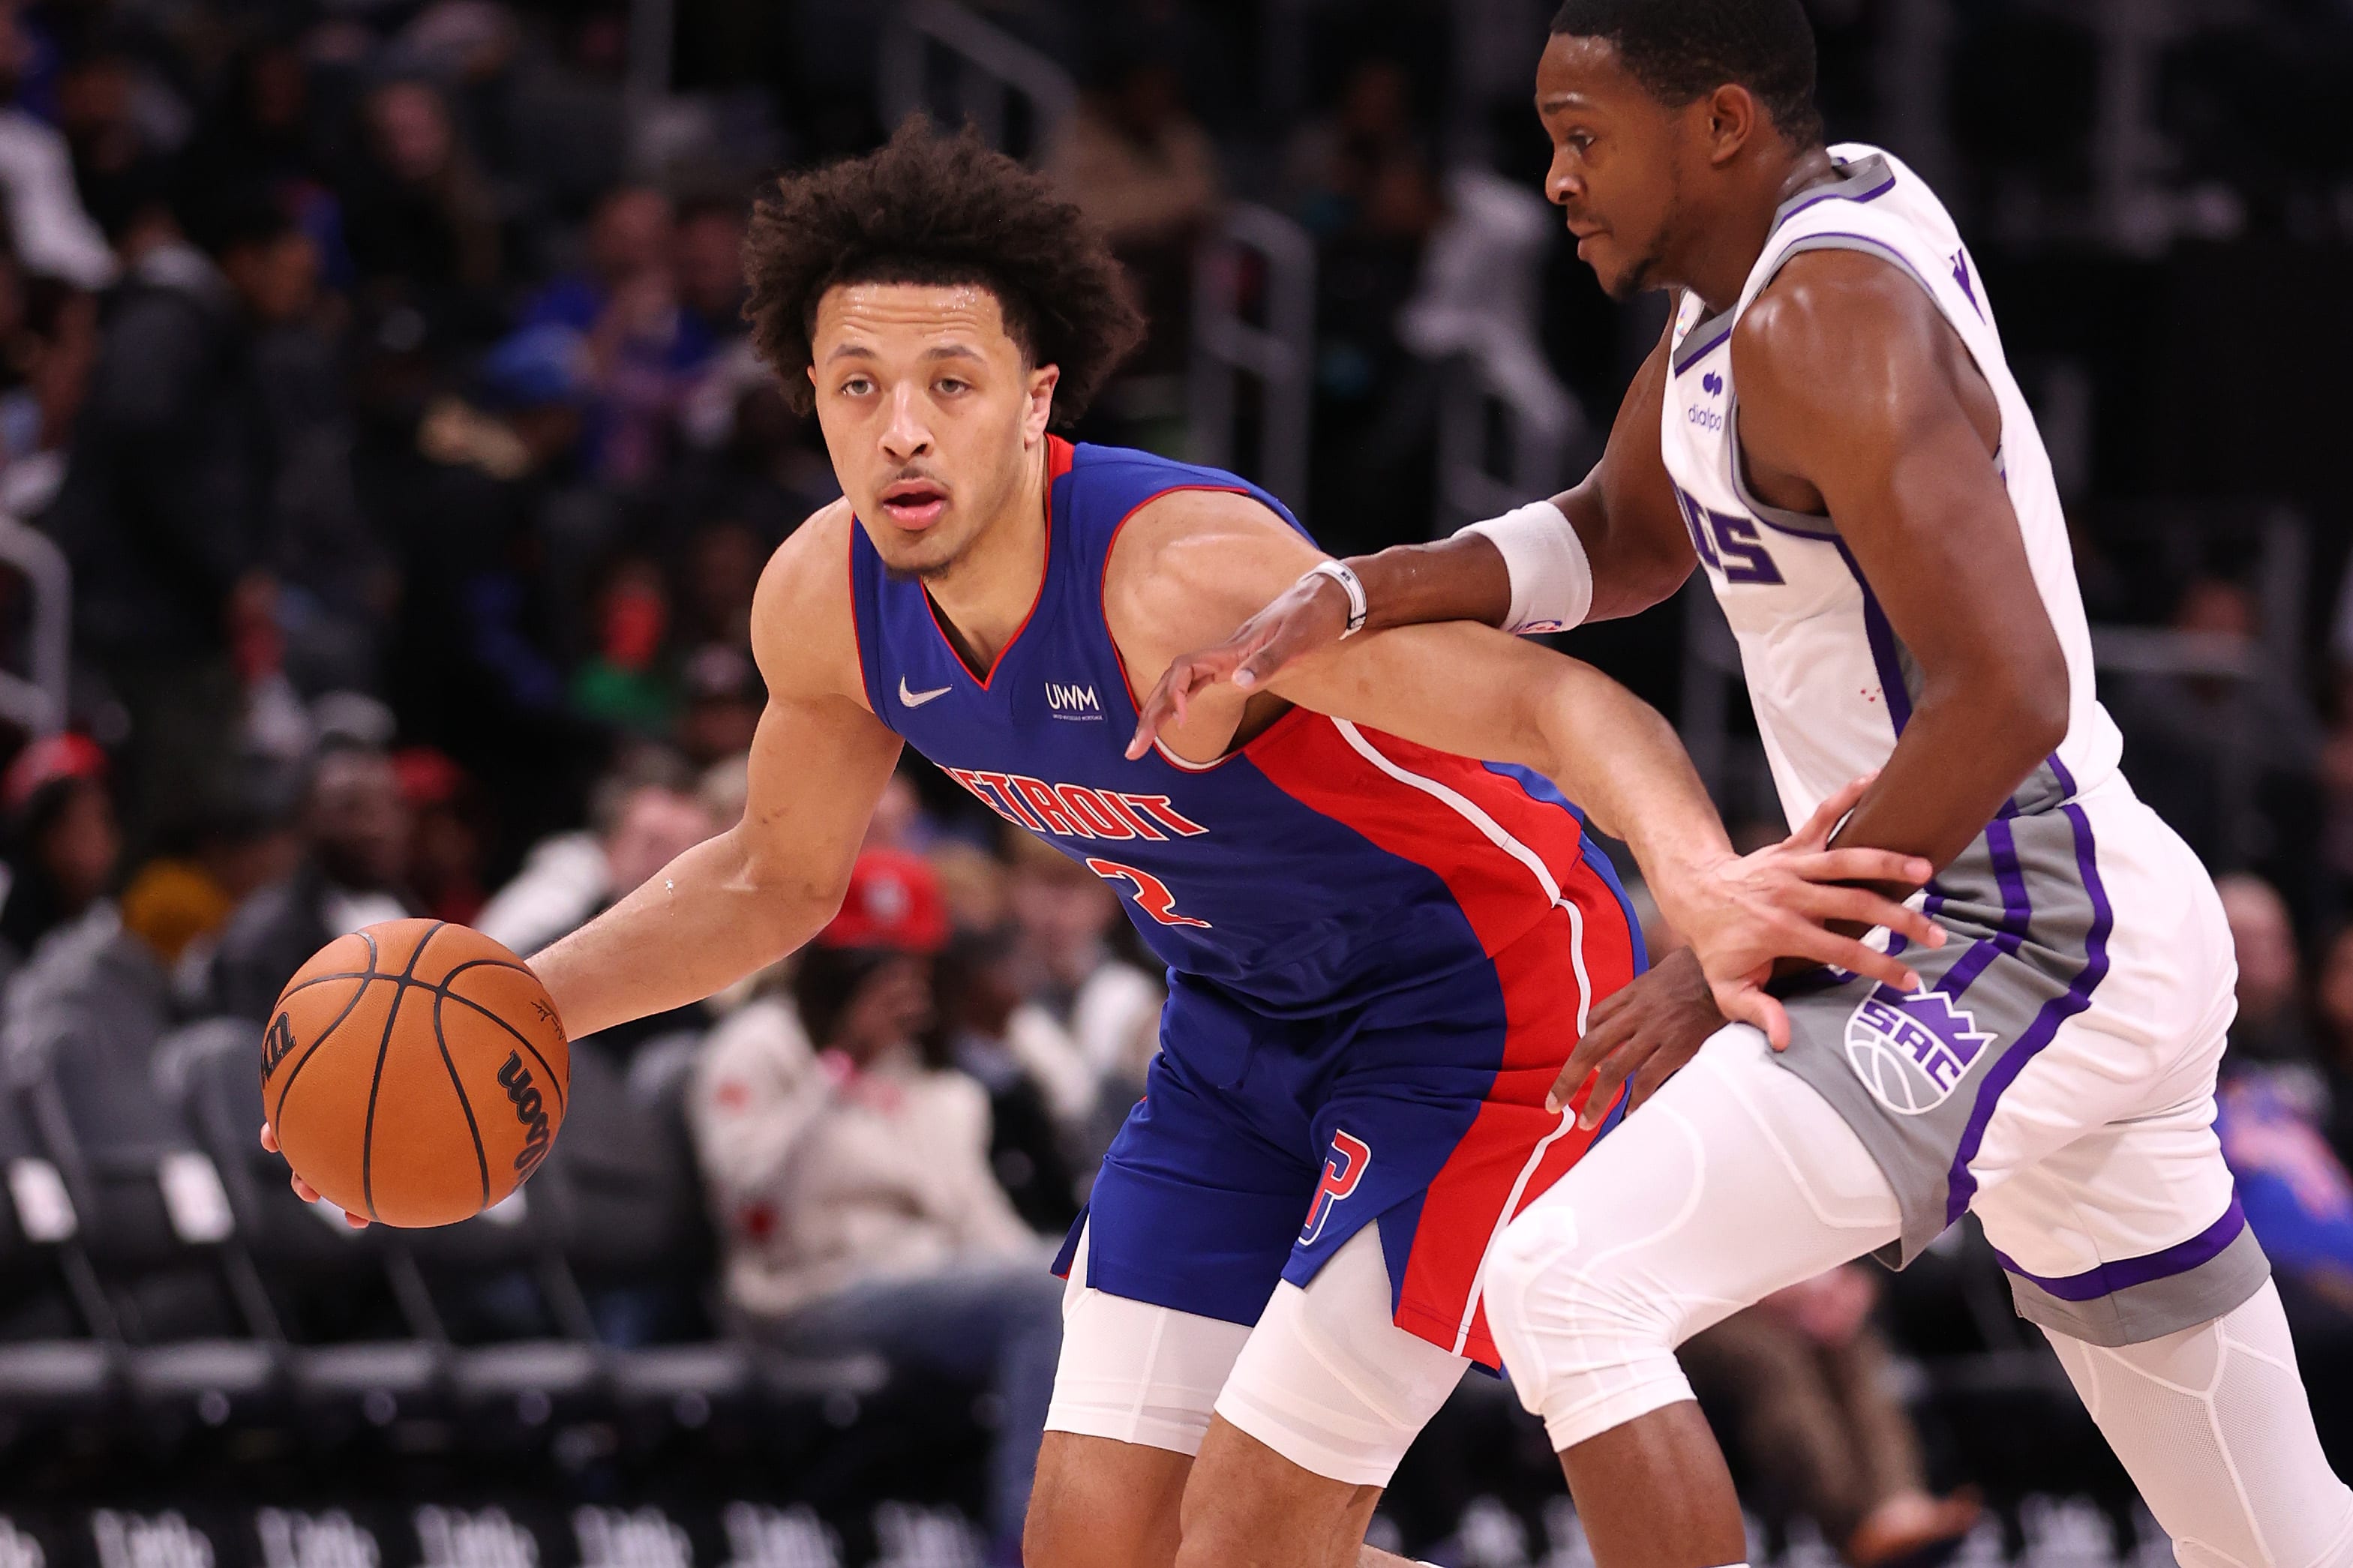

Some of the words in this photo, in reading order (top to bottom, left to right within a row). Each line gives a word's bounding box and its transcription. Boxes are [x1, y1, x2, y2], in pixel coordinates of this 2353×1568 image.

[1045, 682, 1100, 711] UWM
[933, 762, 1210, 841] ETROIT
[1085, 857, 1213, 928] 2
[1856, 1000, 1961, 1093] SAC
[498, 1049, 550, 1182] lson
